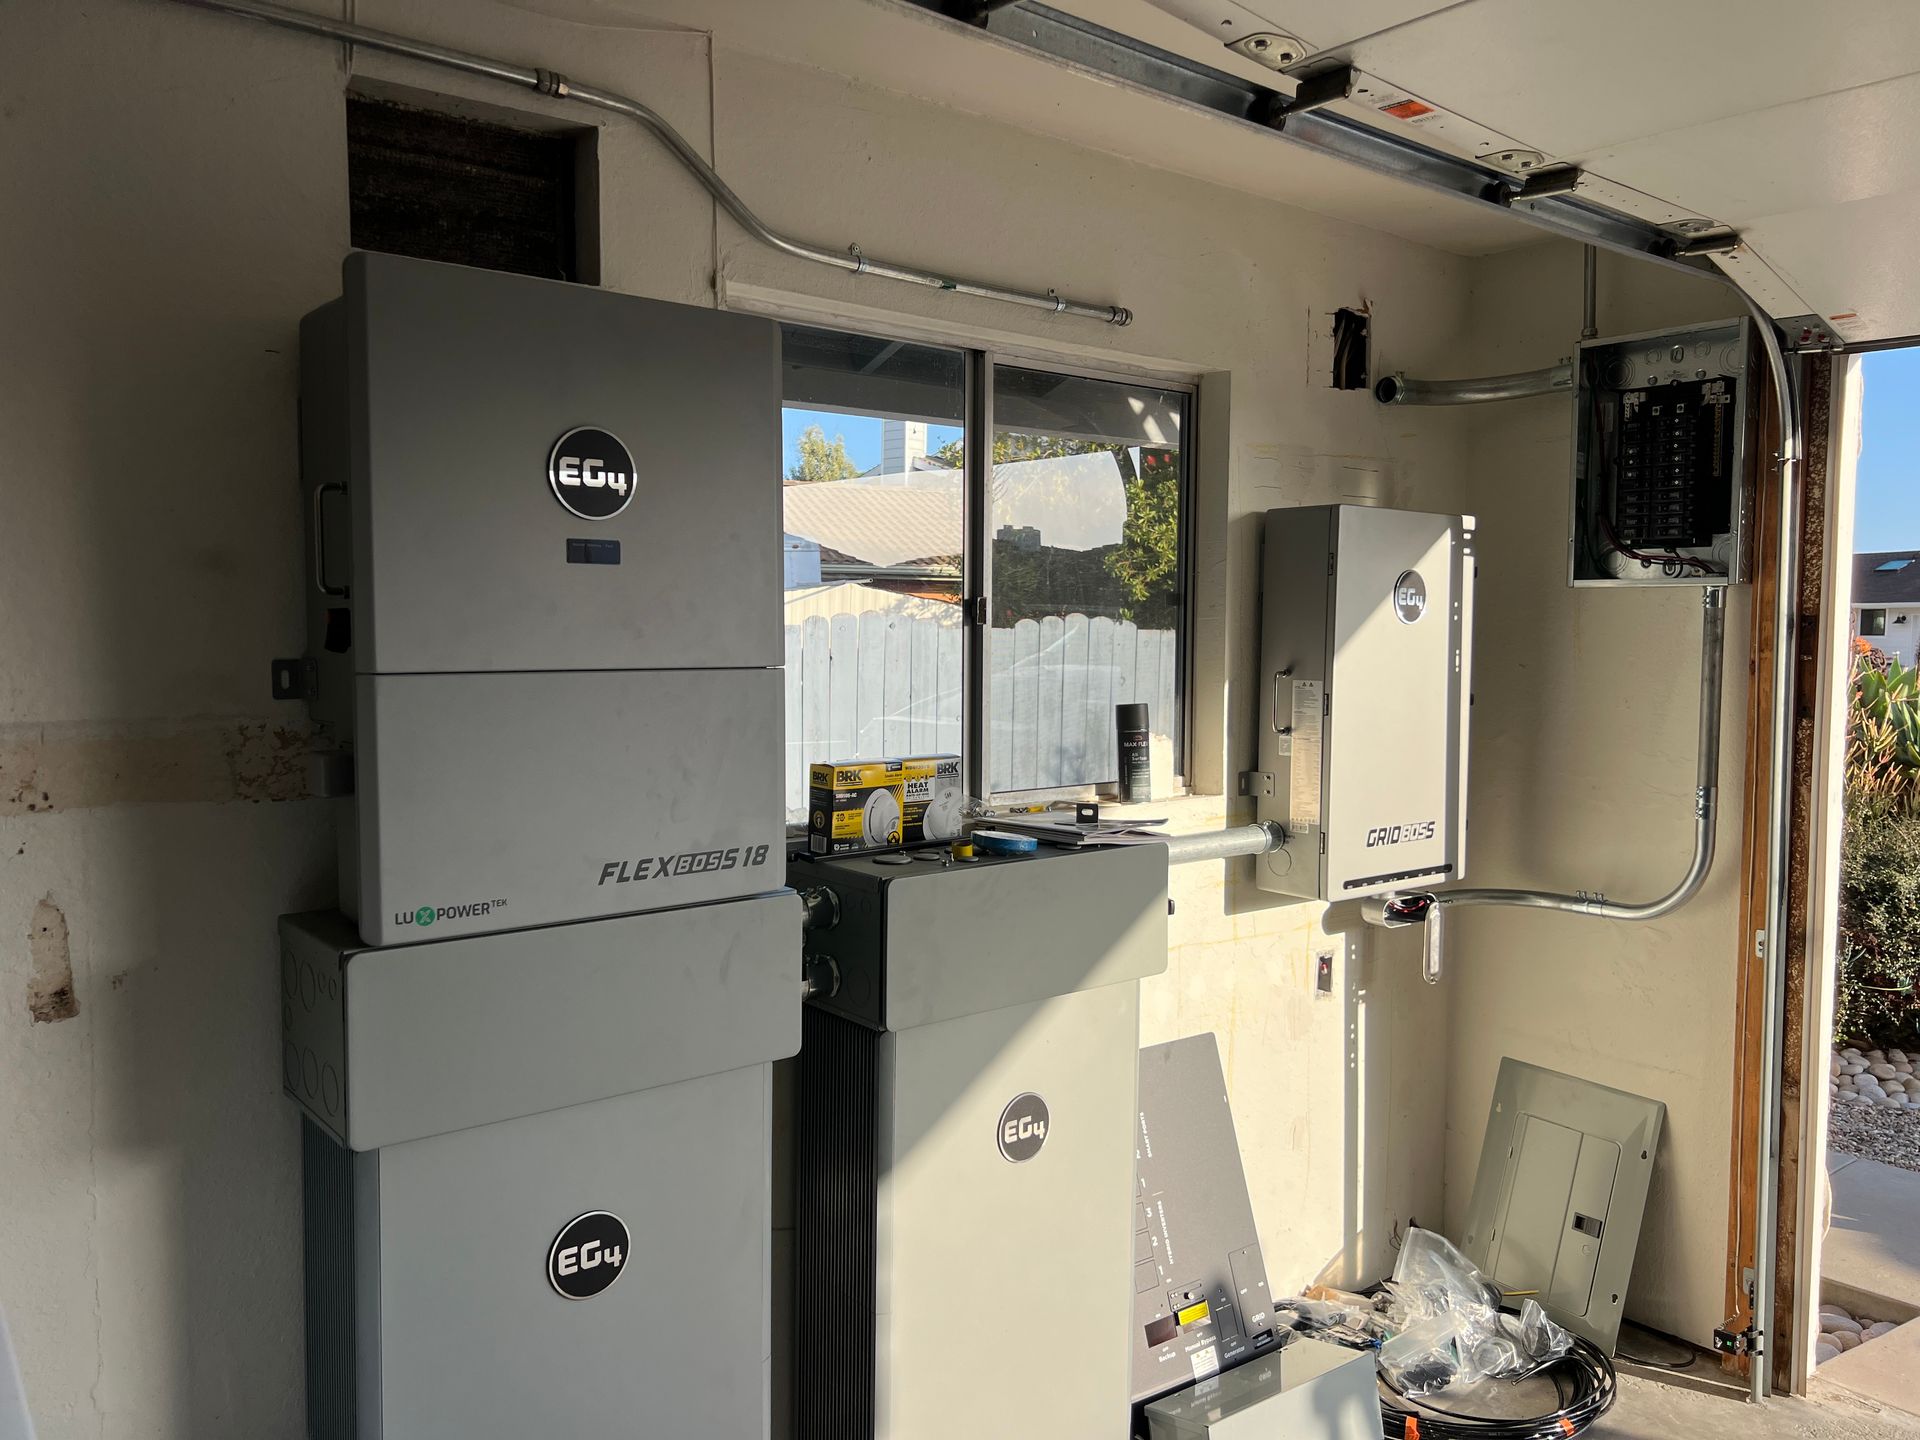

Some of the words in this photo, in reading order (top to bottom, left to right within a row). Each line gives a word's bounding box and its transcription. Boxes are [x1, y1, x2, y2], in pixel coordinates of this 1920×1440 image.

[558, 456, 627, 496] EG4
[1398, 587, 1423, 610] EG4
[937, 762, 960, 774] BRK
[812, 771, 828, 783] BRK
[836, 769, 862, 782] BRK
[907, 781, 928, 789] HEAT
[1366, 821, 1436, 848] GRIDBOSS
[1004, 1115, 1045, 1144] EG4
[1151, 1236, 1159, 1247] 2
[558, 1239, 622, 1277] EG4
[1158, 1265, 1164, 1276] 1
[1252, 1312, 1265, 1323] GRID
[1158, 1351, 1176, 1363] Backup
